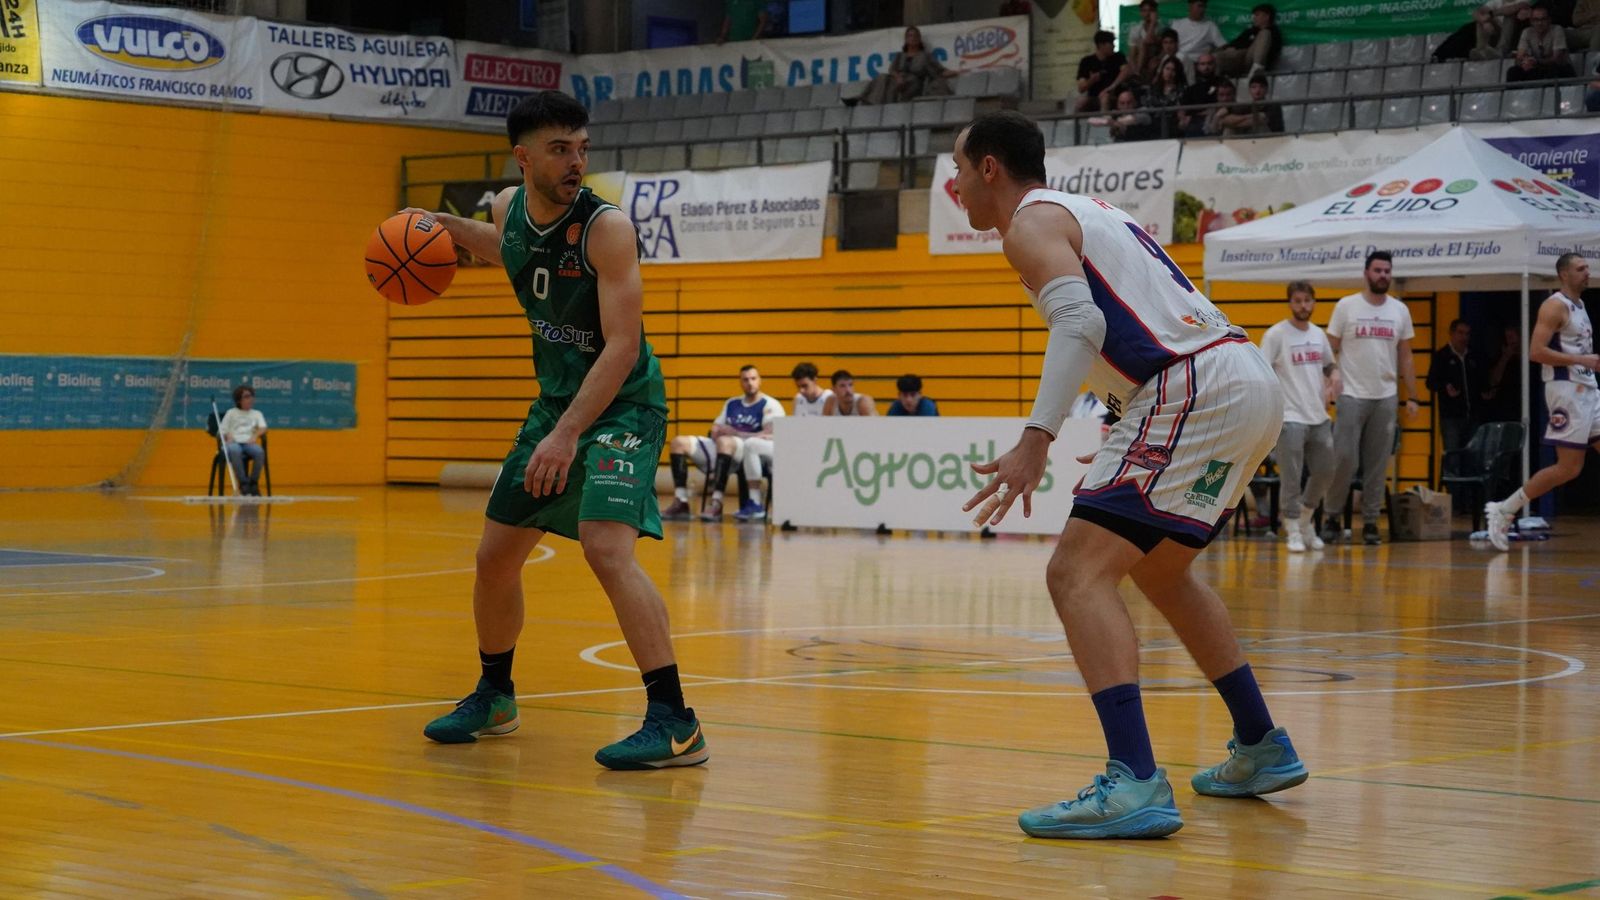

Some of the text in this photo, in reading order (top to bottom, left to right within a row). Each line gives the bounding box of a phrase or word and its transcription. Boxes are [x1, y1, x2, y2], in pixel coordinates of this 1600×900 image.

[1306, 4, 1373, 19] INAGROUP
[92, 23, 209, 63] VULCO
[268, 26, 450, 58] TALLERES AGUILERA
[350, 63, 450, 89] HYUNDAI
[471, 58, 556, 86] ELECTRO
[51, 68, 254, 100] NEUMÁTICOS FRANCISCO RAMOS
[1050, 167, 1164, 195] uditores
[681, 202, 714, 217] Eladio
[749, 200, 759, 214] &
[761, 196, 821, 213] Asociados
[1322, 197, 1460, 216] EL EJIDO
[1220, 241, 1502, 264] Instituto Municipal de Deortes de El Ejido
[1355, 327, 1367, 337] LA
[0, 372, 34, 387] ioline
[57, 373, 102, 388] Bioline
[189, 375, 231, 389] Bioline
[252, 376, 292, 390] Bioline
[312, 377, 352, 392] Bioline
[816, 437, 1055, 506] Agroatls
